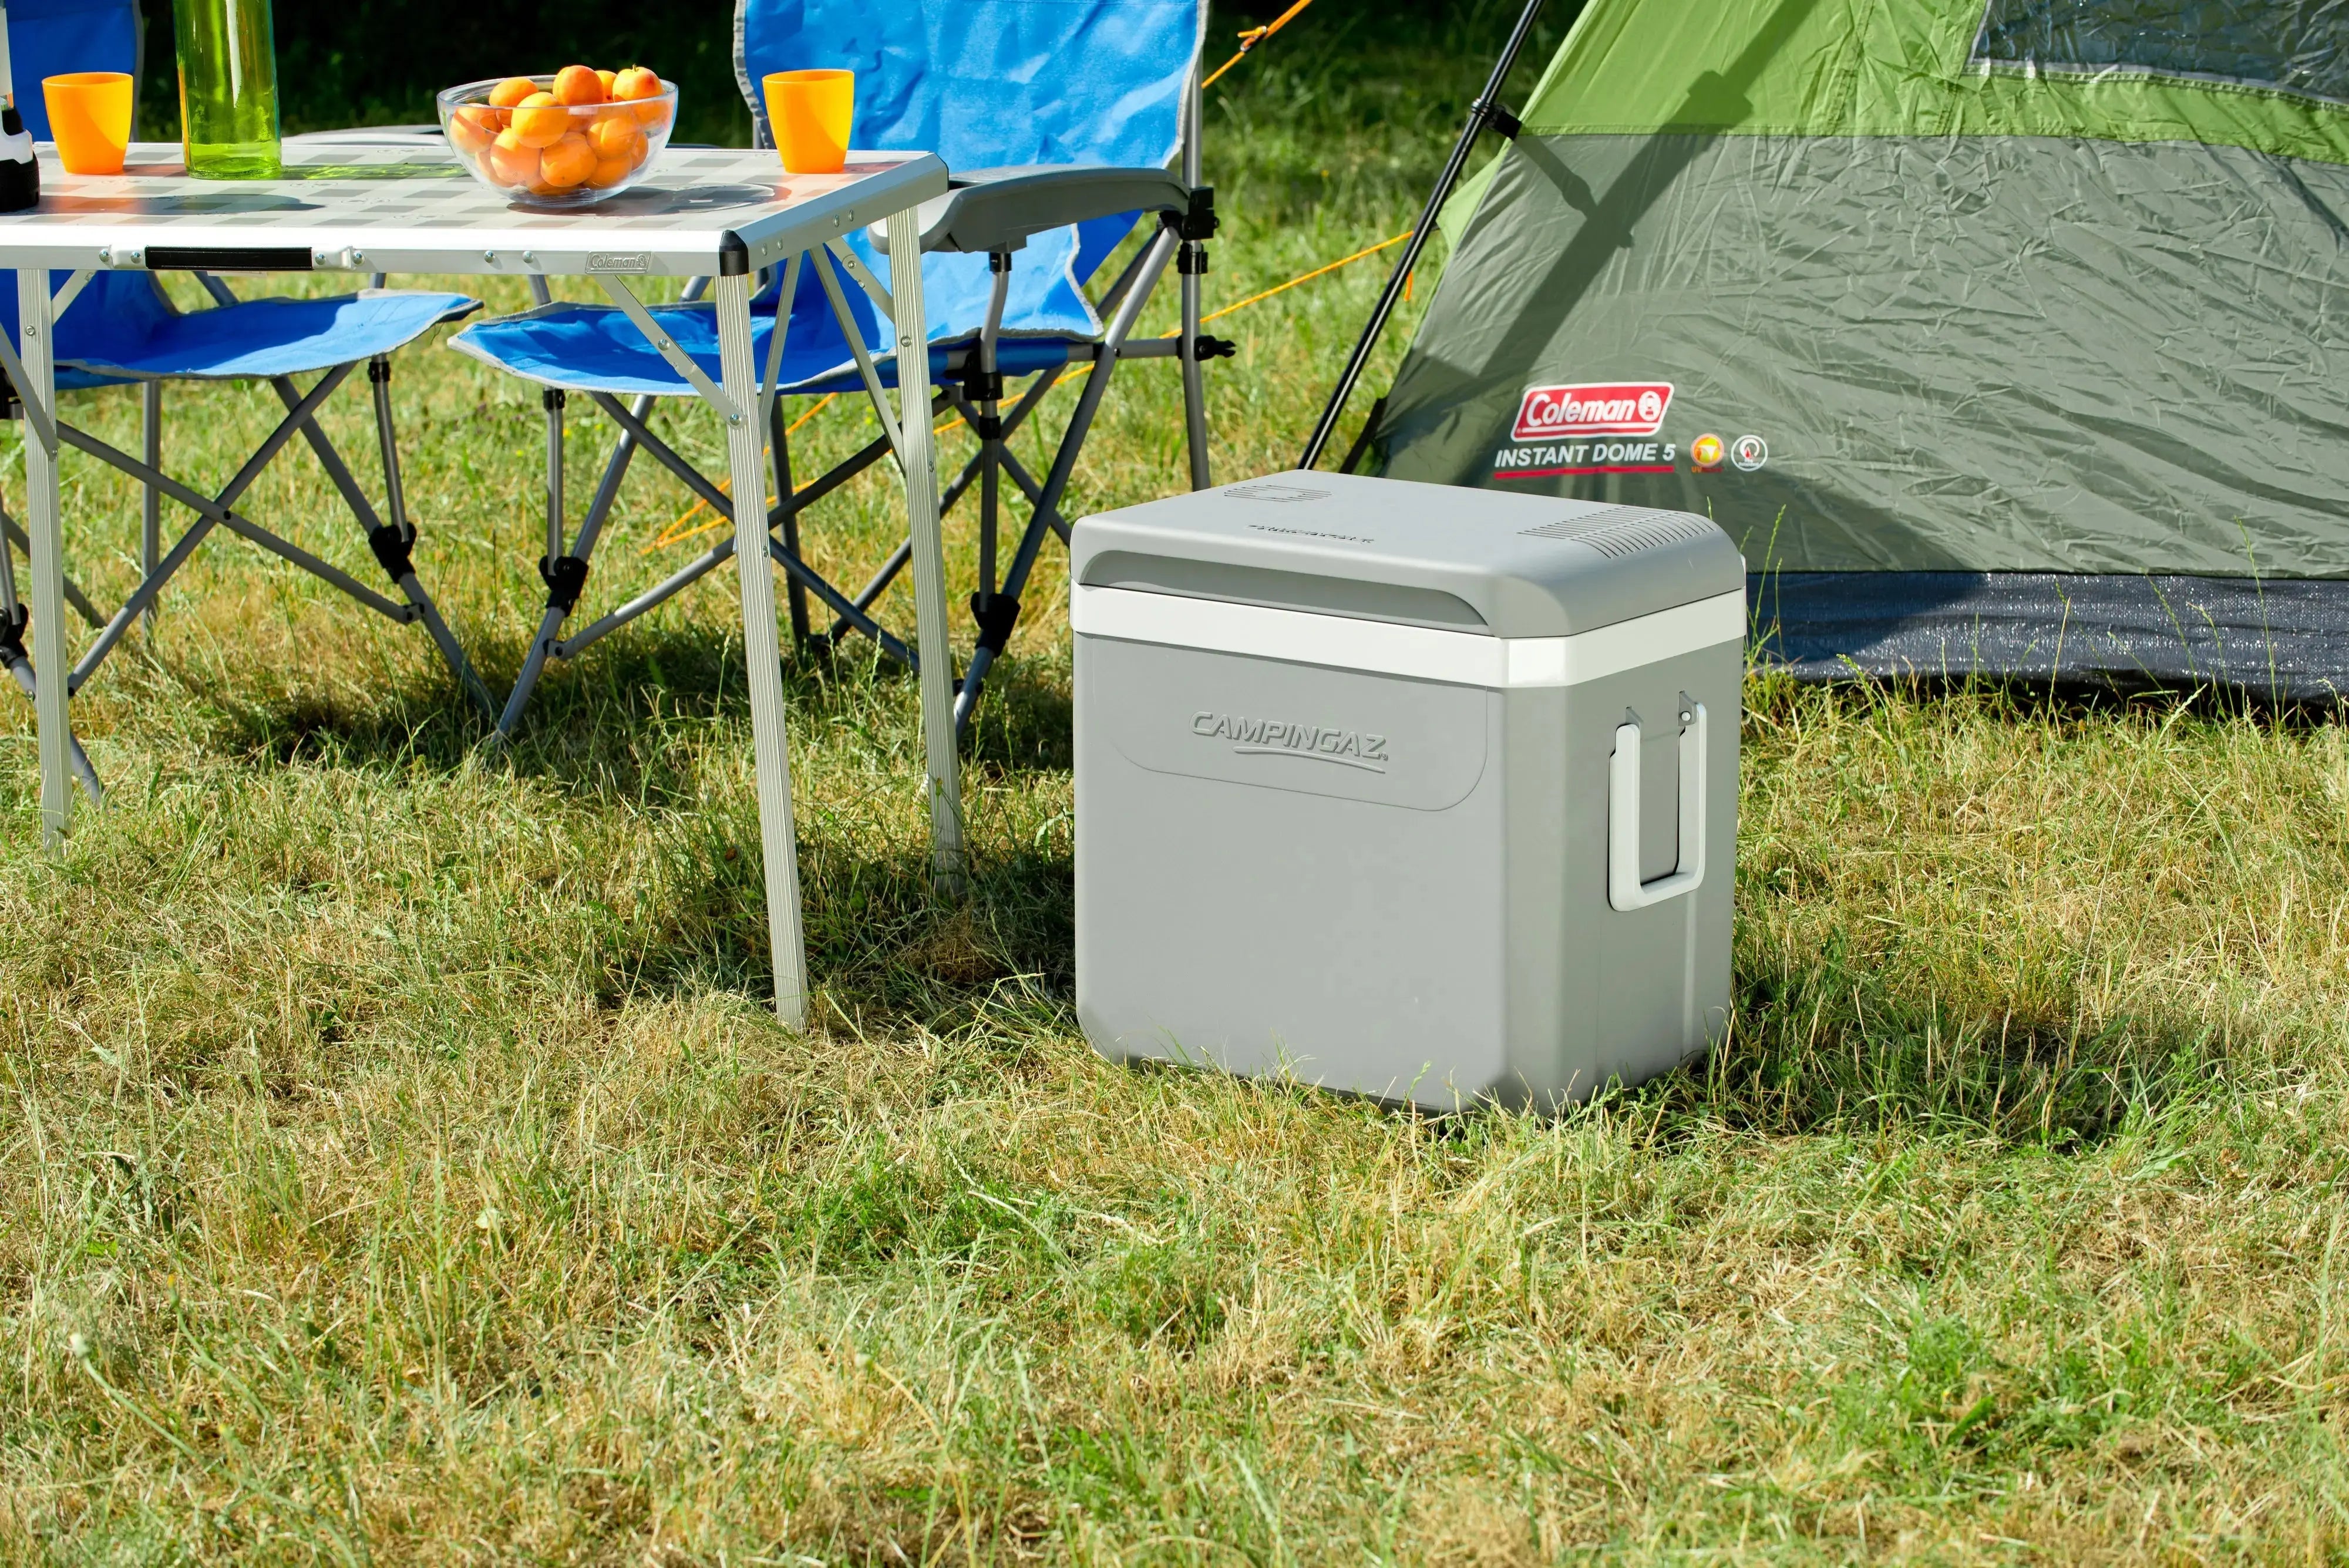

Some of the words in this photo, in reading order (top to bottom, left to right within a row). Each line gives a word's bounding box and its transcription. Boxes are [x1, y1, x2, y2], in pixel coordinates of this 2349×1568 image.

[590, 253, 637, 268] Coleman
[1527, 392, 1635, 427] Coleman
[1495, 445, 1589, 468] INSTANT
[1592, 443, 1657, 463] DOME
[1662, 443, 1676, 462] 5
